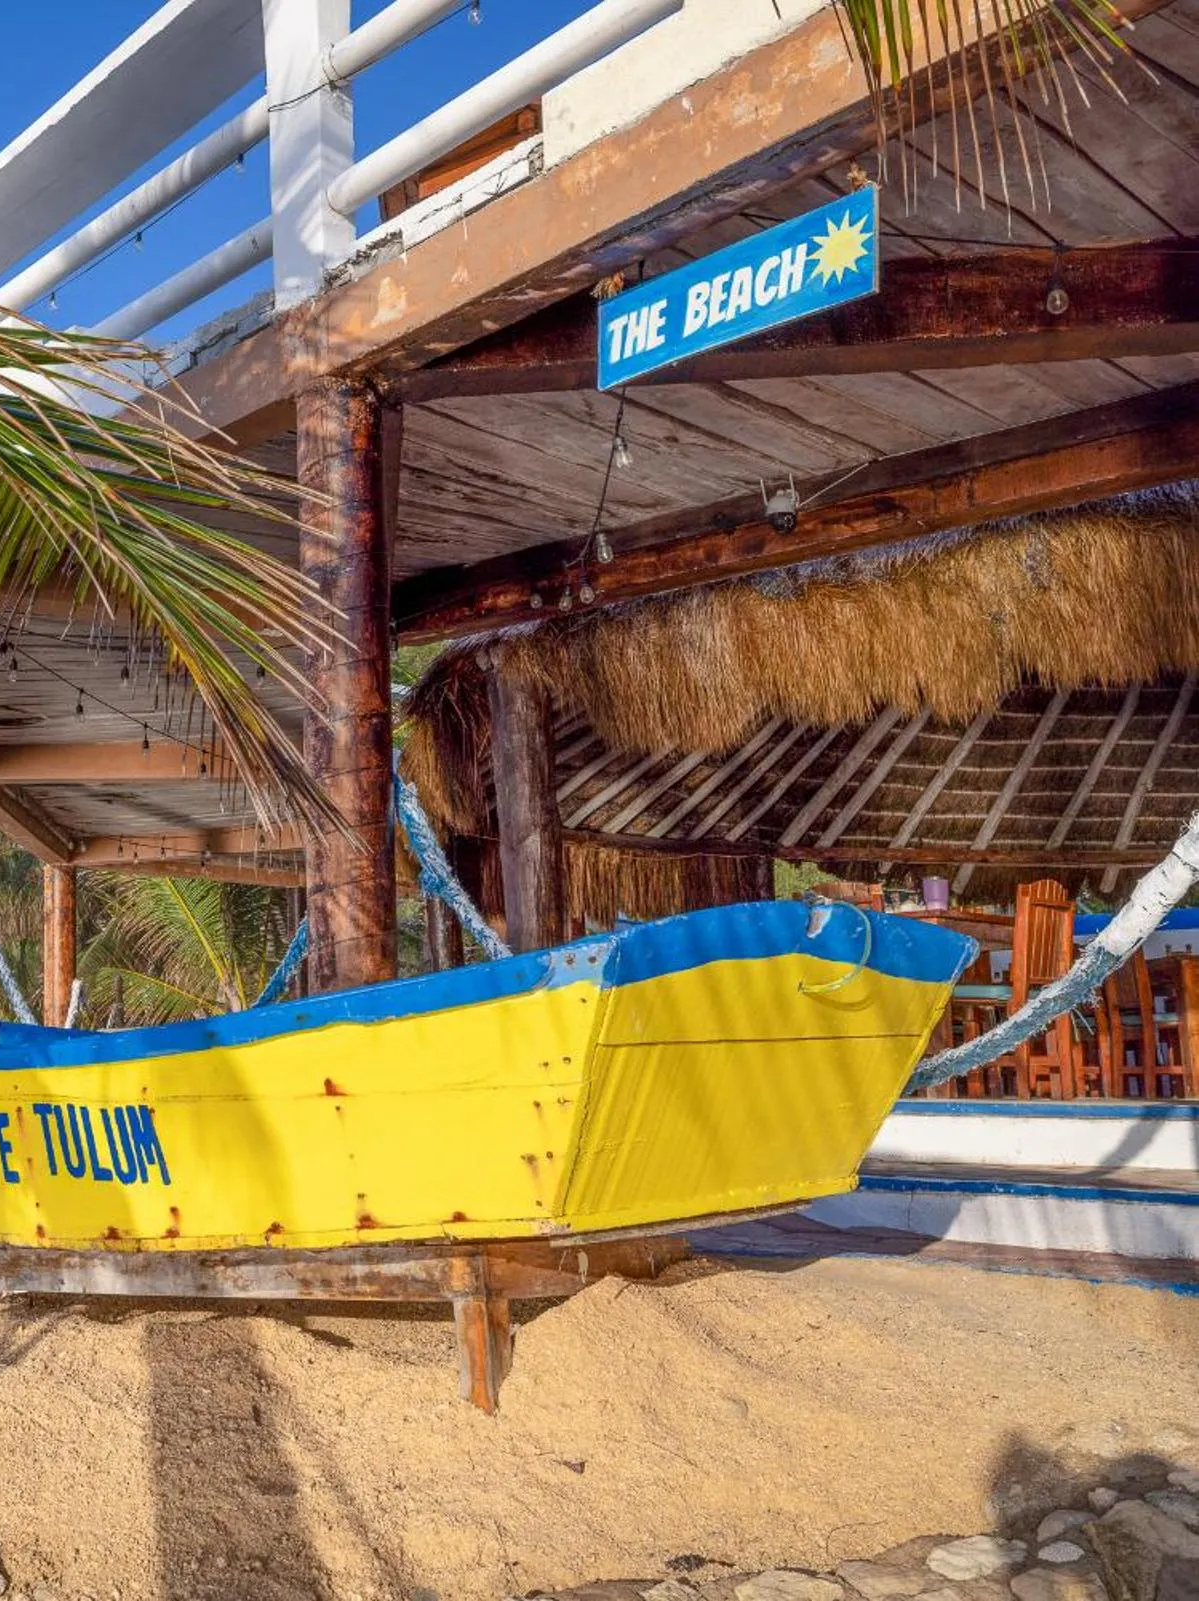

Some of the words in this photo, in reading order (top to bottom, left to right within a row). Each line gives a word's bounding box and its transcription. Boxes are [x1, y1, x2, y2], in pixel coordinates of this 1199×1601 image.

[607, 298, 668, 364] THE
[682, 243, 808, 338] BEACH
[33, 1103, 171, 1185] TULUM
